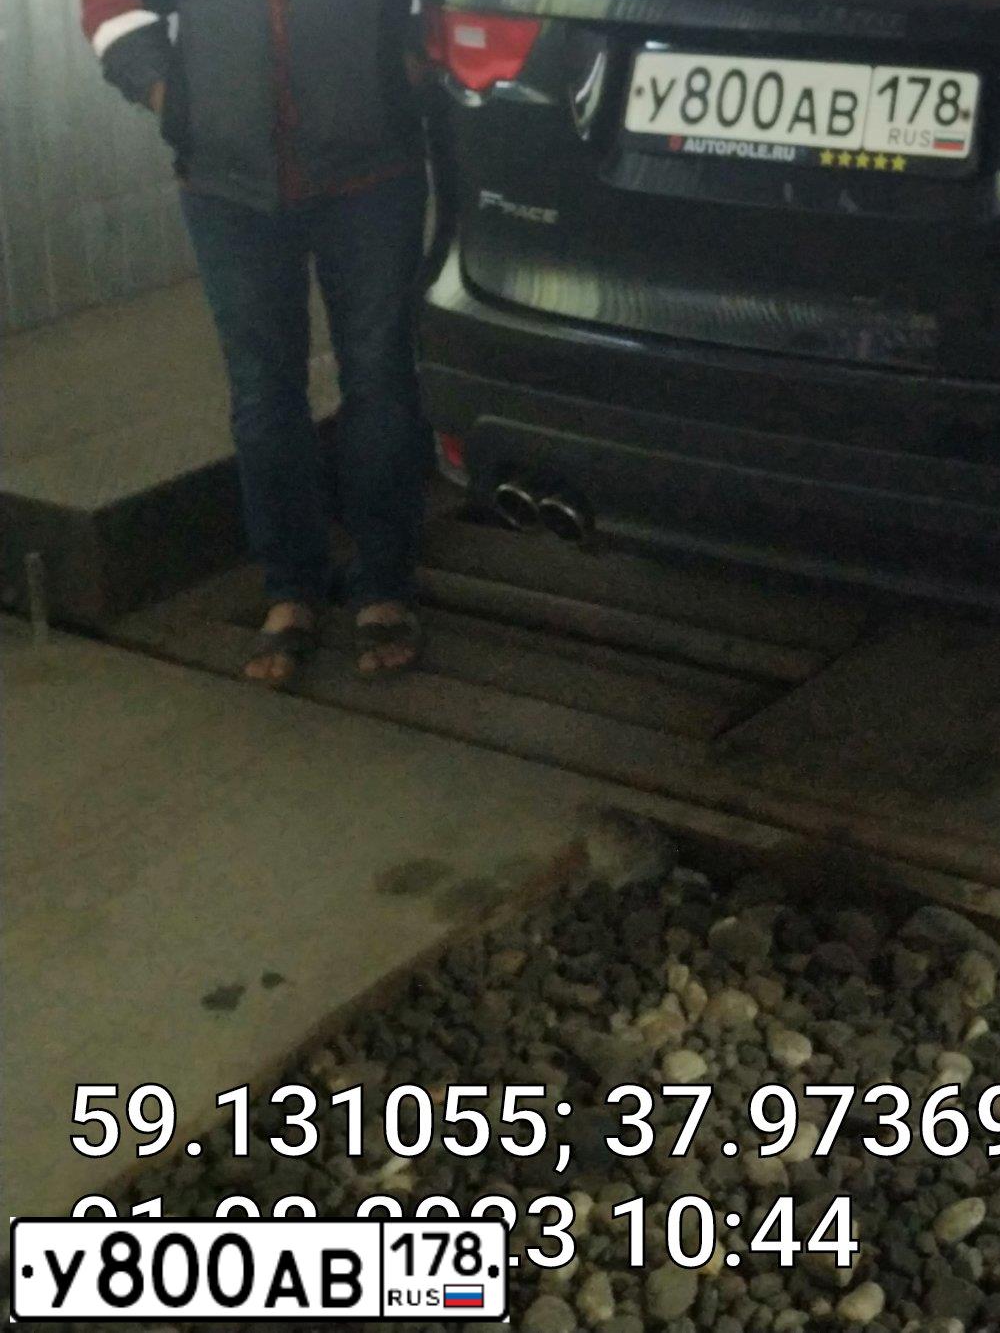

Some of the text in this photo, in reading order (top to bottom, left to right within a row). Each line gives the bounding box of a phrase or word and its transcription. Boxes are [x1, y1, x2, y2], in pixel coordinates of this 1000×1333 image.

[877, 76, 962, 127] 178
[684, 138, 796, 162] AUTOPOLE.RU
[887, 129, 931, 148] RUS
